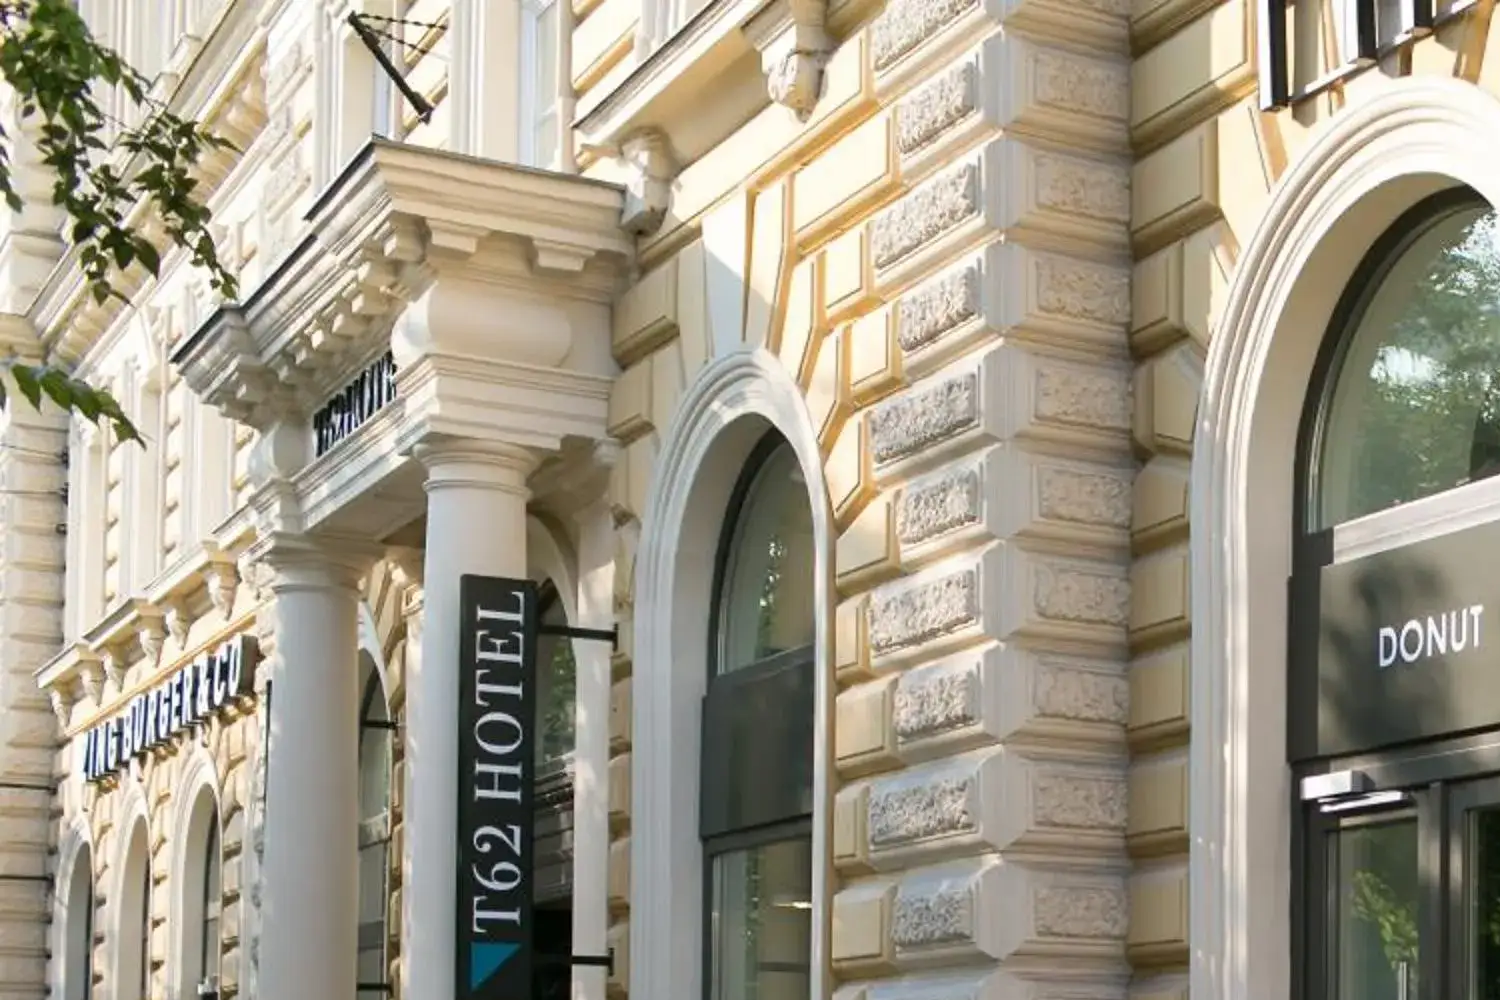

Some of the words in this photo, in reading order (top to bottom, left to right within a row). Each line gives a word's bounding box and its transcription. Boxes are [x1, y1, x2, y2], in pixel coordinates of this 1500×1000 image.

[1378, 603, 1485, 667] DONUT
[121, 662, 194, 762] BURGER
[474, 591, 525, 802] HOTEL
[473, 825, 521, 933] T62
